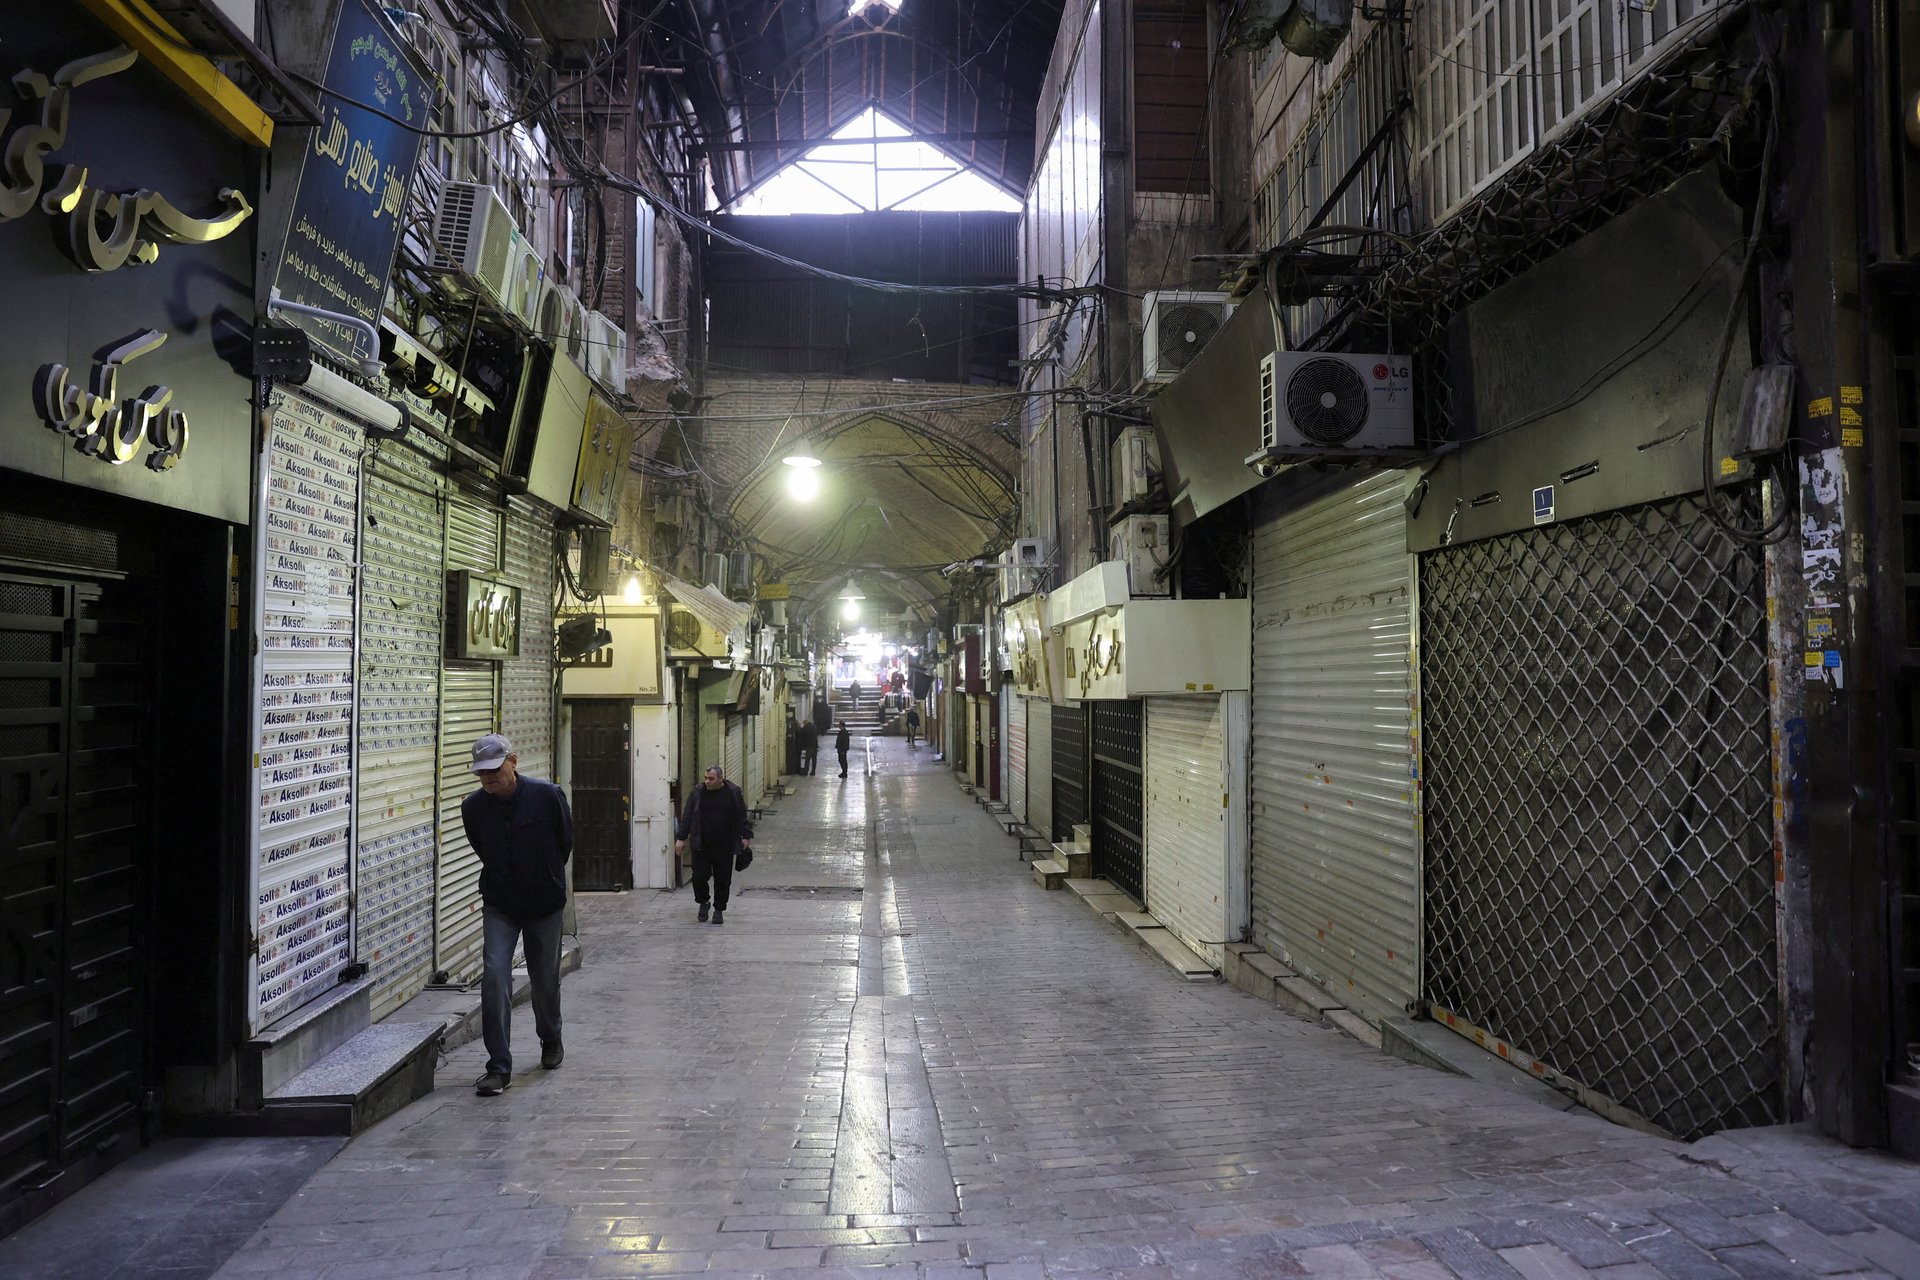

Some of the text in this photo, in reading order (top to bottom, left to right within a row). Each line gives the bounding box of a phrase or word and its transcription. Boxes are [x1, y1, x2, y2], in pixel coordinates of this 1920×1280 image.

[314, 105, 406, 231] پاساژ صنایع دستی
[296, 214, 317, 240] فروش
[321, 240, 335, 255] خرید
[285, 250, 304, 272] جواهر
[310, 264, 320, 281] طلا
[357, 262, 366, 277] طلا
[320, 274, 346, 301] سفارشات
[364, 274, 380, 292] بورس
[351, 296, 376, 322] تعمیرات
[1392, 367, 1408, 377] LG
[273, 416, 290, 430] soll
[304, 427, 327, 445] Aksoll
[300, 403, 324, 424] Aksoll
[336, 422, 358, 440] Aksoll
[274, 435, 299, 454] Aksoll
[313, 450, 335, 470] Aksoll
[286, 459, 345, 490] Aksoll Aksoll
[270, 477, 283, 488] soll
[298, 482, 321, 499] Aksoll
[286, 499, 346, 525] Aksoll Aksoll
[268, 513, 293, 530] Aksoll
[308, 523, 330, 539] Aksoll
[290, 540, 313, 556] Aksoll
[273, 575, 298, 591] Aksoll
[282, 616, 304, 628] Akso
[291, 635, 314, 648] Aksoll
[264, 674, 289, 687] Aksoll
[306, 673, 328, 684] Aksoll
[263, 696, 276, 707] soll
[293, 693, 316, 704] Aksoll
[265, 712, 291, 724] Aksoll
[306, 711, 328, 723] Aksoll
[278, 727, 339, 744] Aksoll Aksoll
[263, 744, 350, 766] soll Aksoll Aksol
[273, 769, 298, 783] Aksoll
[313, 763, 335, 775] Aksoll
[280, 779, 340, 802] Aksoll Aksoll
[270, 809, 295, 824] Aksoll
[310, 800, 332, 813] Aksoll
[269, 834, 332, 863] Aksoll Aksoll
[259, 889, 274, 904] soll
[290, 876, 313, 893] Aksoll
[276, 885, 336, 918] Aksoll Aksoll
[276, 904, 337, 938] Aksoll Aksoll
[258, 916, 346, 966] soll Aksoll Aksoll
[258, 965, 280, 986] ksoll
[296, 947, 319, 966] Aksoll
[333, 933, 348, 947] Akso
[260, 982, 287, 1005] Aksoll
[302, 963, 326, 982] Aksoll
